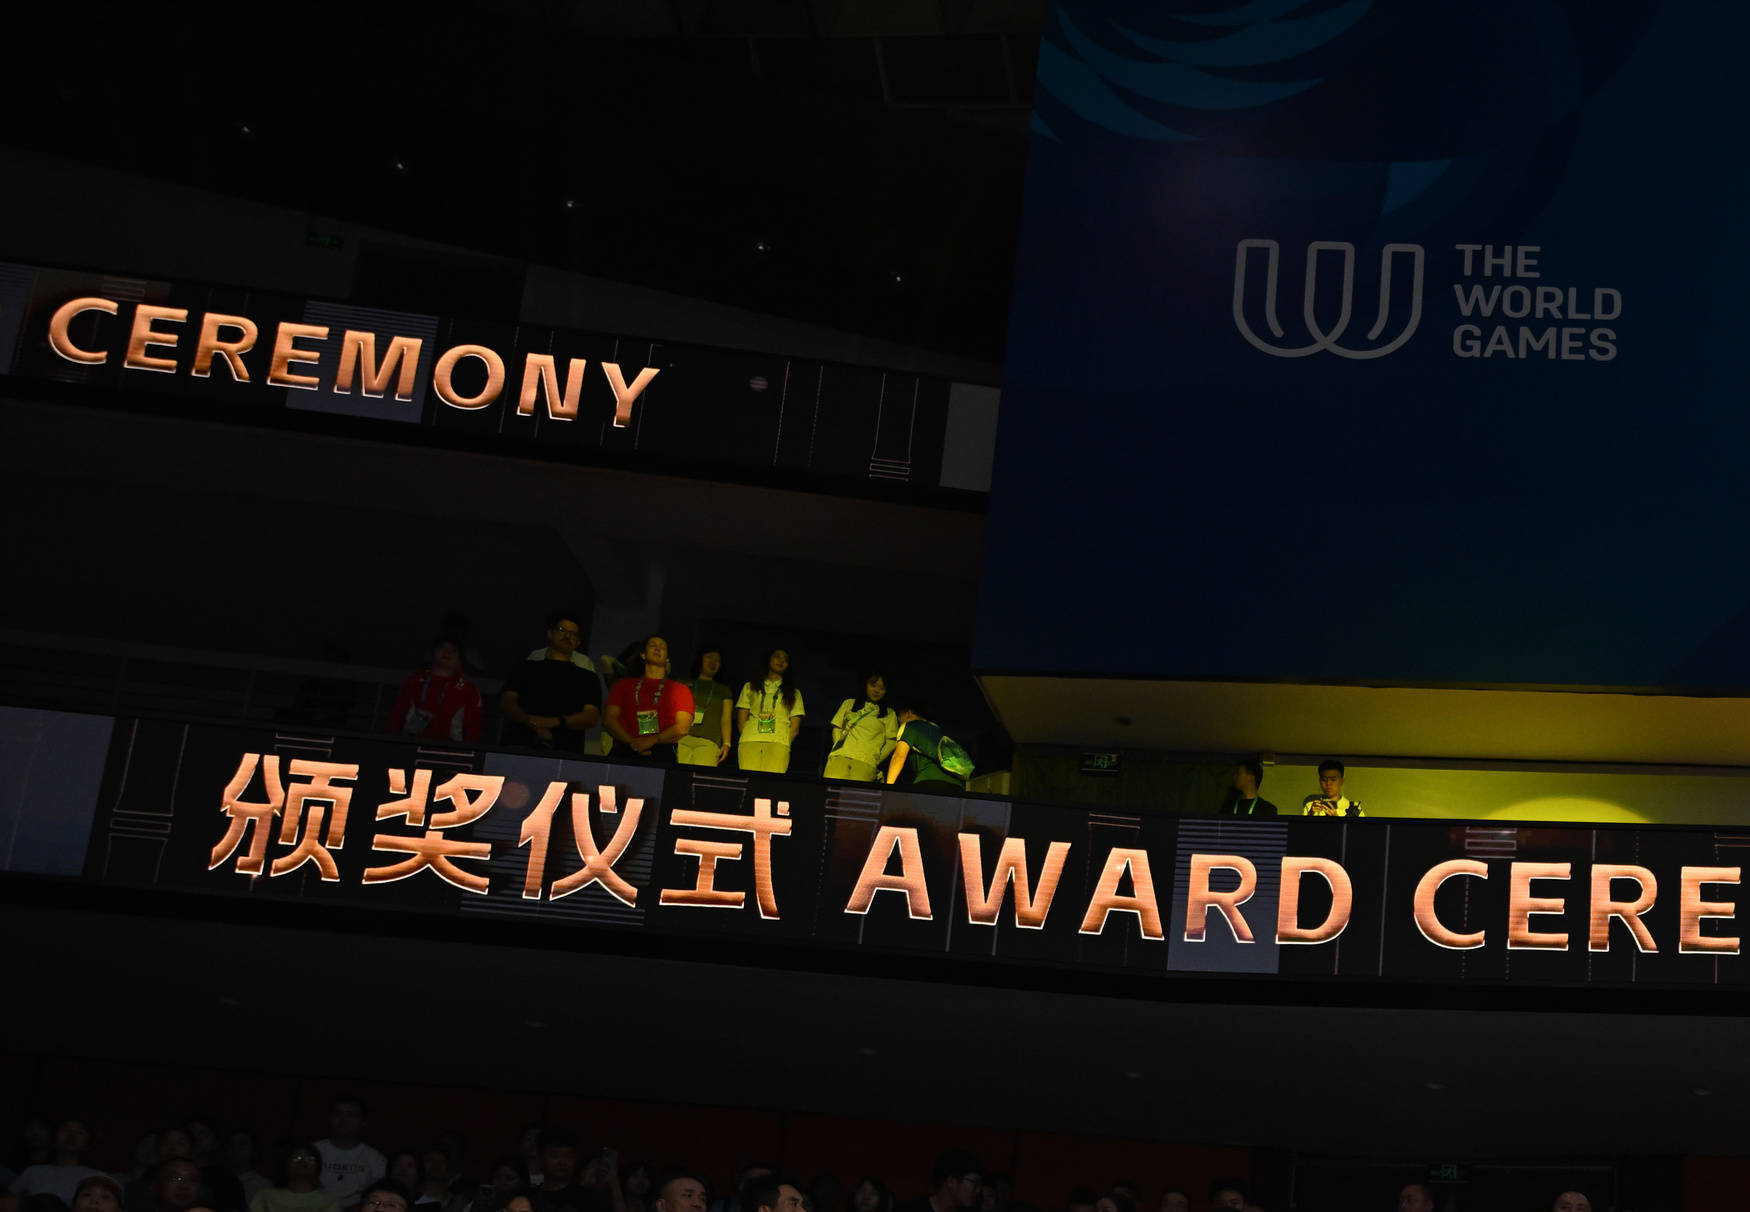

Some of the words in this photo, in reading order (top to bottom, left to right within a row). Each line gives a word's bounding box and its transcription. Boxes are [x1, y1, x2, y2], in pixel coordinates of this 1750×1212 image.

[1455, 243, 1542, 279] THE
[1453, 283, 1623, 321] WORLD
[48, 296, 660, 428] CEREMONY
[1452, 323, 1618, 362] GAMES
[207, 752, 793, 921] 颁奖仪式
[844, 825, 1353, 945] AWARD
